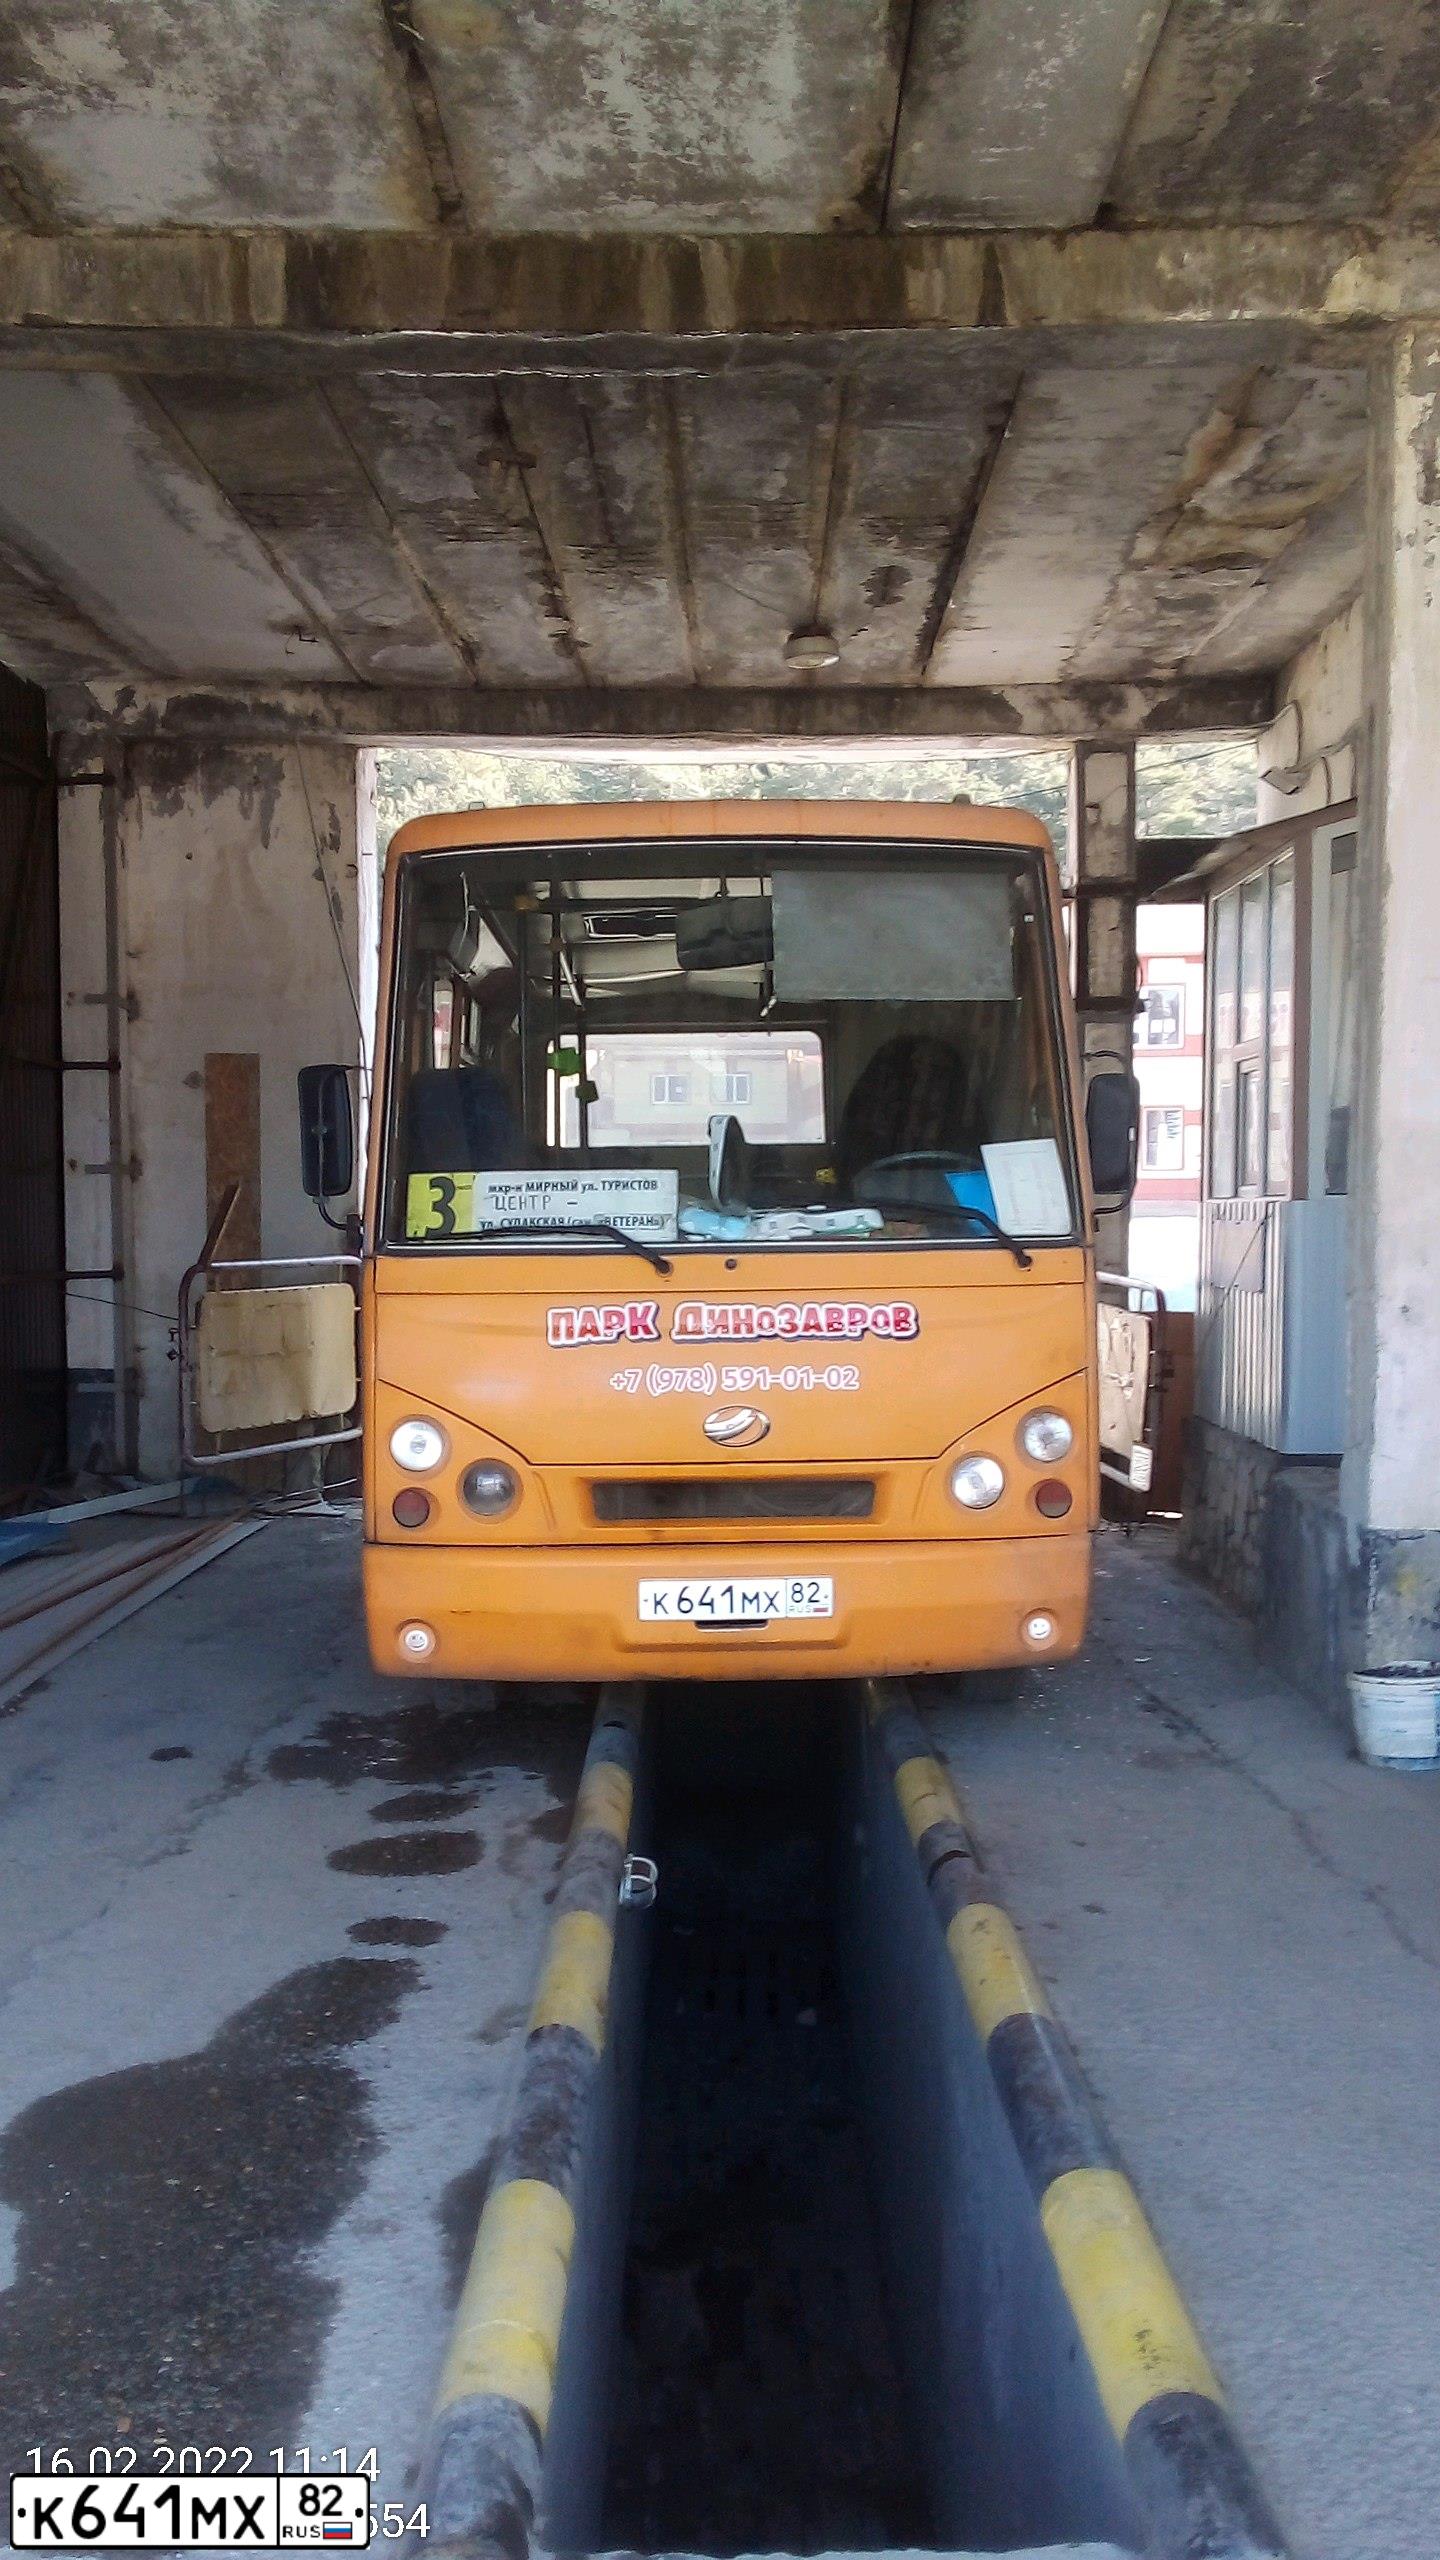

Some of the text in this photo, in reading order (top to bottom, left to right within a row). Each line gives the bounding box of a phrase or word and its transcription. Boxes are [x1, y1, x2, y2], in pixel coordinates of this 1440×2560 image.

[488, 1179, 659, 1195] мкр-н МИРНЫЙ ул. ТУРИСТОВ
[425, 1176, 456, 1238] 3
[495, 1195, 552, 1211] ЦЕНТР
[547, 1301, 919, 1346] ПАРК ДИНОЗАВРОВ
[609, 1362, 860, 1396] +7 (978) 591-01-02
[791, 1582, 820, 1603] 82
